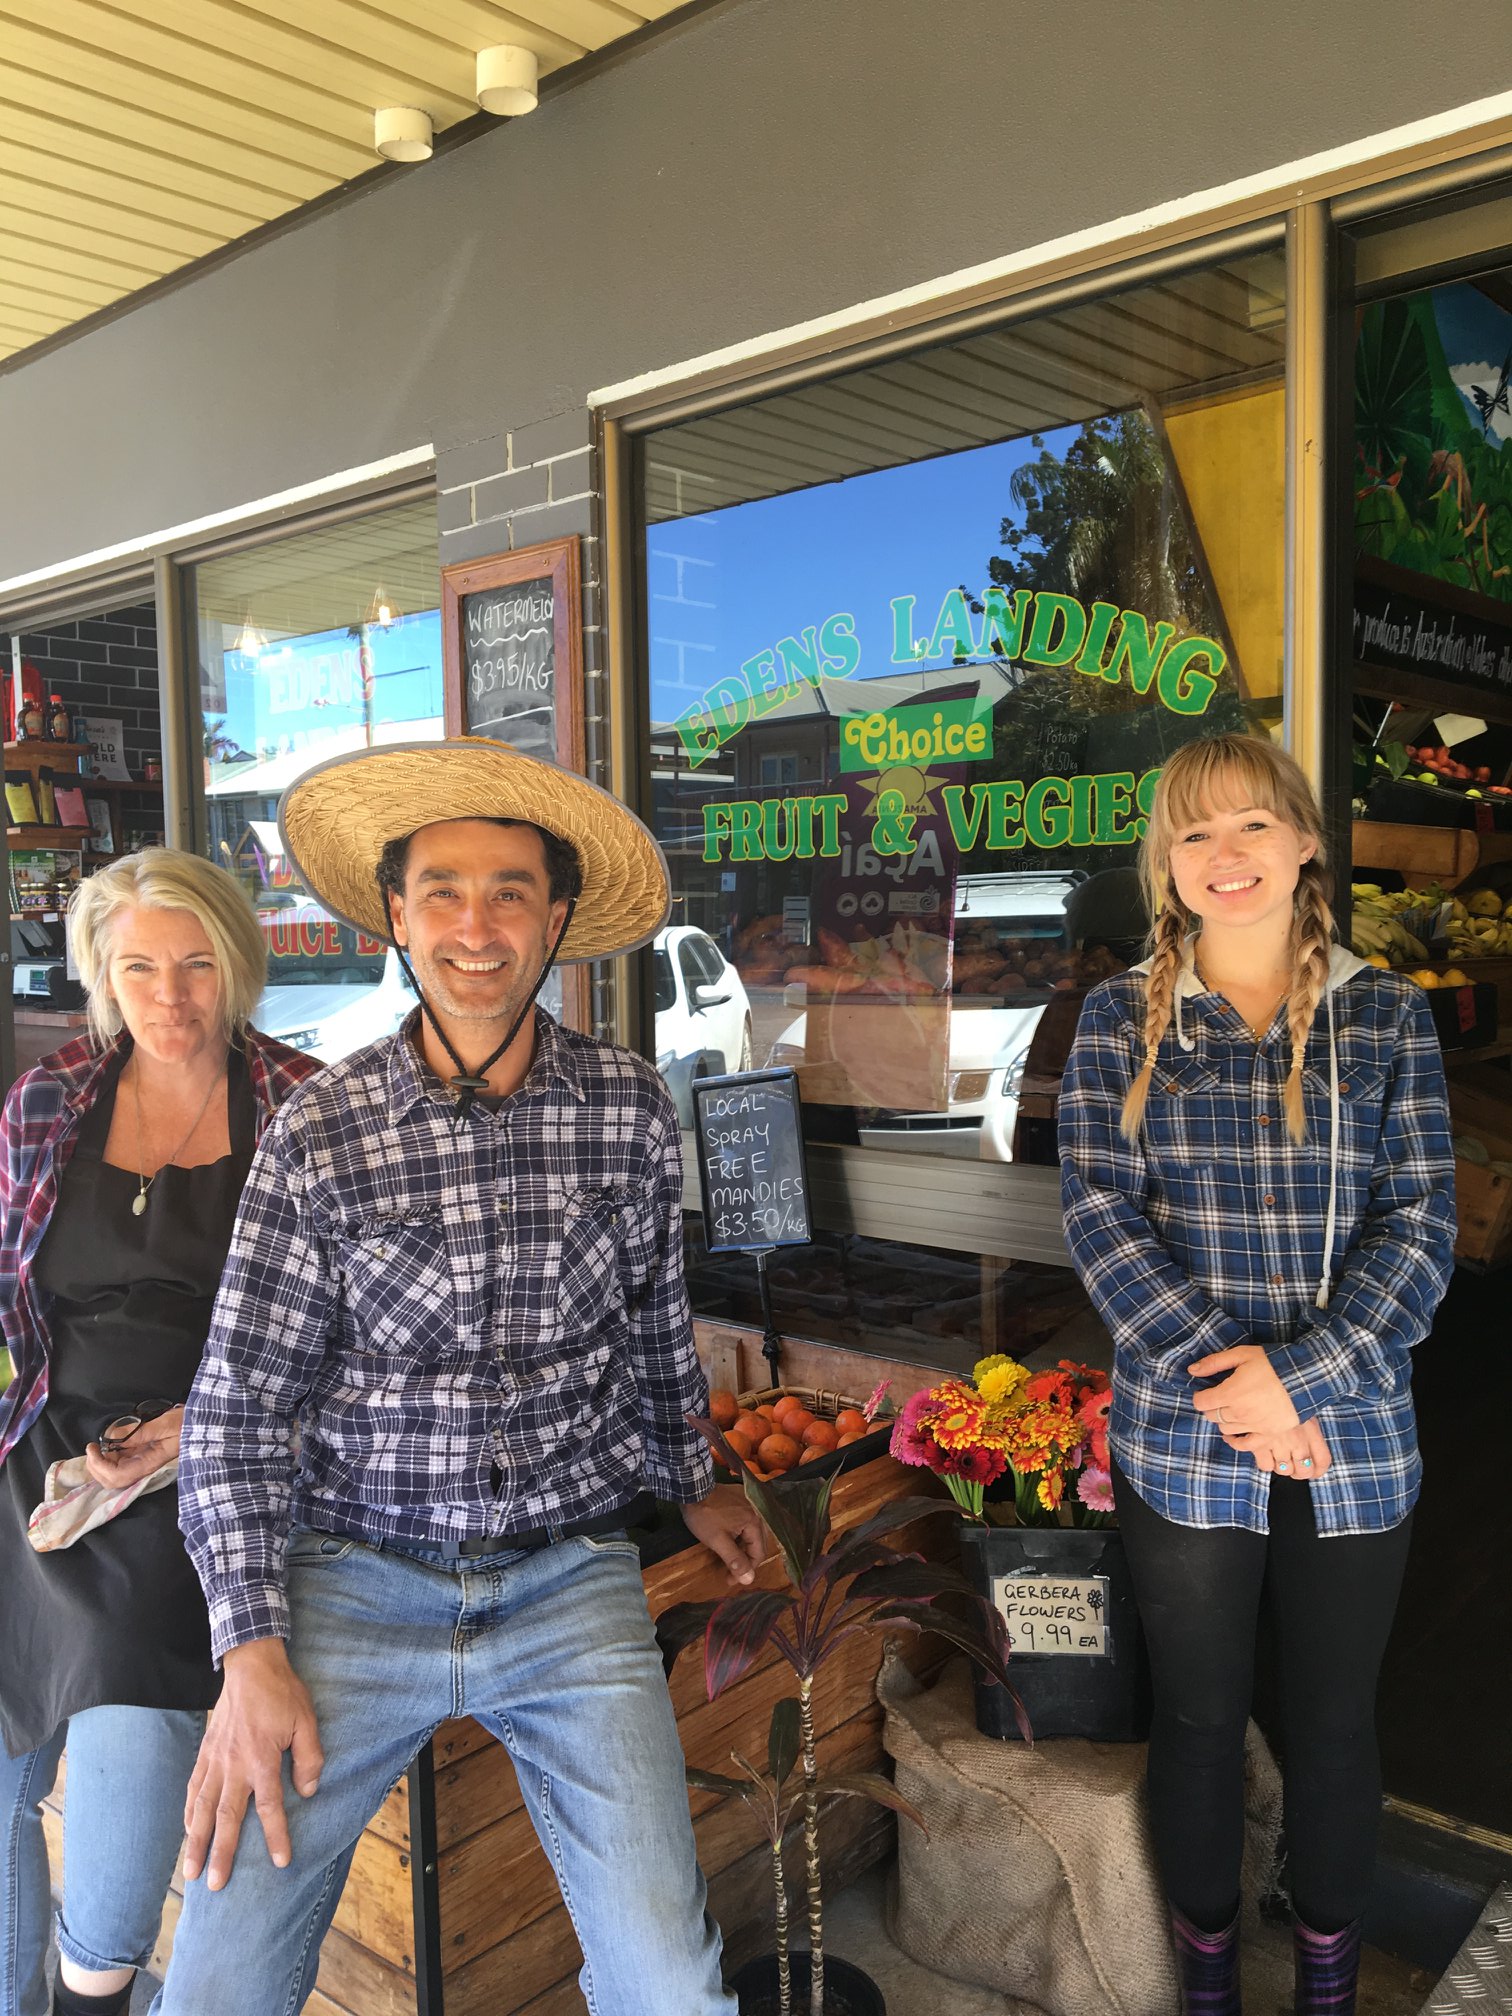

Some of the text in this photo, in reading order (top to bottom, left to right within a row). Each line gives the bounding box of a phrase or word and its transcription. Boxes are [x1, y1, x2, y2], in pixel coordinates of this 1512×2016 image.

[471, 652, 554, 702] $3.95/KG
[672, 588, 1228, 770] EDENS LANDING
[90, 742, 115, 753] OLD
[844, 712, 987, 765] Choice
[1046, 725, 1079, 745] Potato
[94, 753, 117, 763] ERE
[702, 794, 848, 863] FRUIT
[872, 789, 918, 856] &
[256, 906, 343, 958] JUICE
[705, 1096, 766, 1118] LOCAL
[706, 1151, 768, 1180] FREE
[711, 1177, 804, 1208] MANDIES
[714, 1203, 807, 1240] $3.50/KG
[1004, 1583, 1081, 1602] GERBERA
[1006, 1603, 1086, 1622] FLOWERS
[1078, 1635, 1098, 1648] EA
